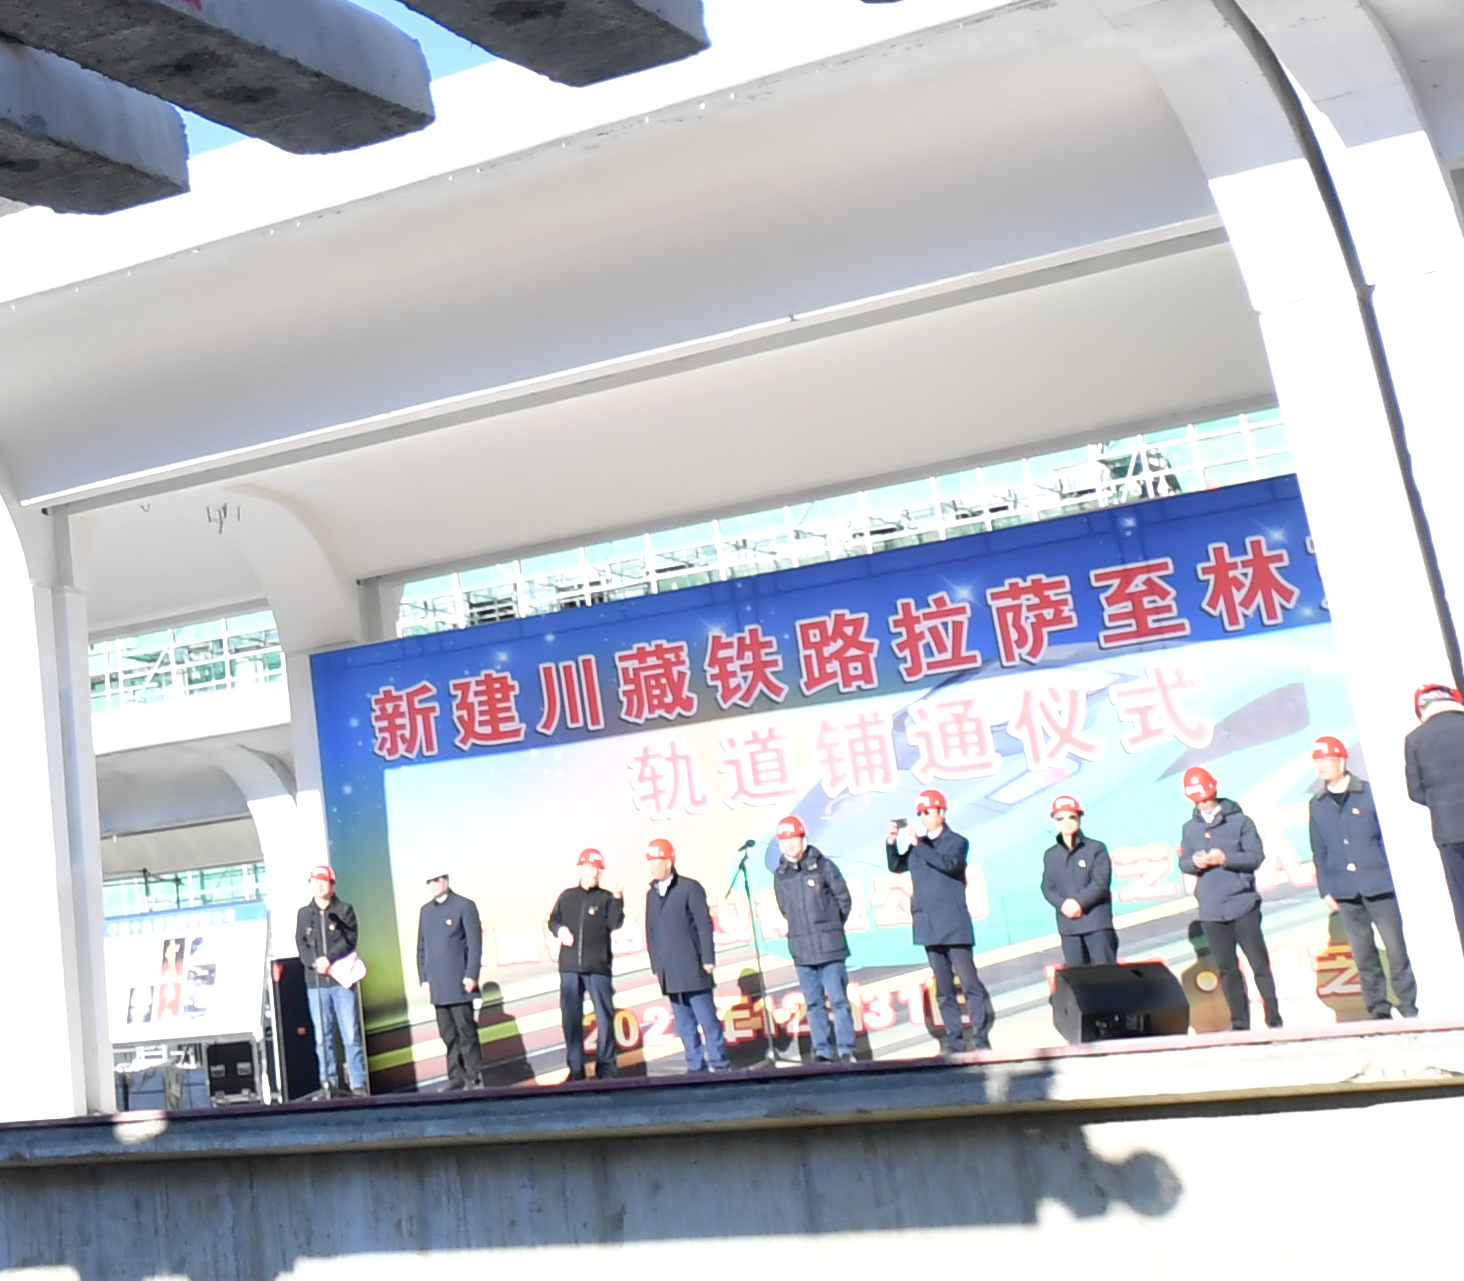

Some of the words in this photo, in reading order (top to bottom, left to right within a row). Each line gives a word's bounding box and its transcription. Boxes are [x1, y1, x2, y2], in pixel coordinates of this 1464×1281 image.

[371, 532, 1326, 760] 新建川藏铁路拉萨至林
[628, 668, 1214, 820] 轨道铺通仪式
